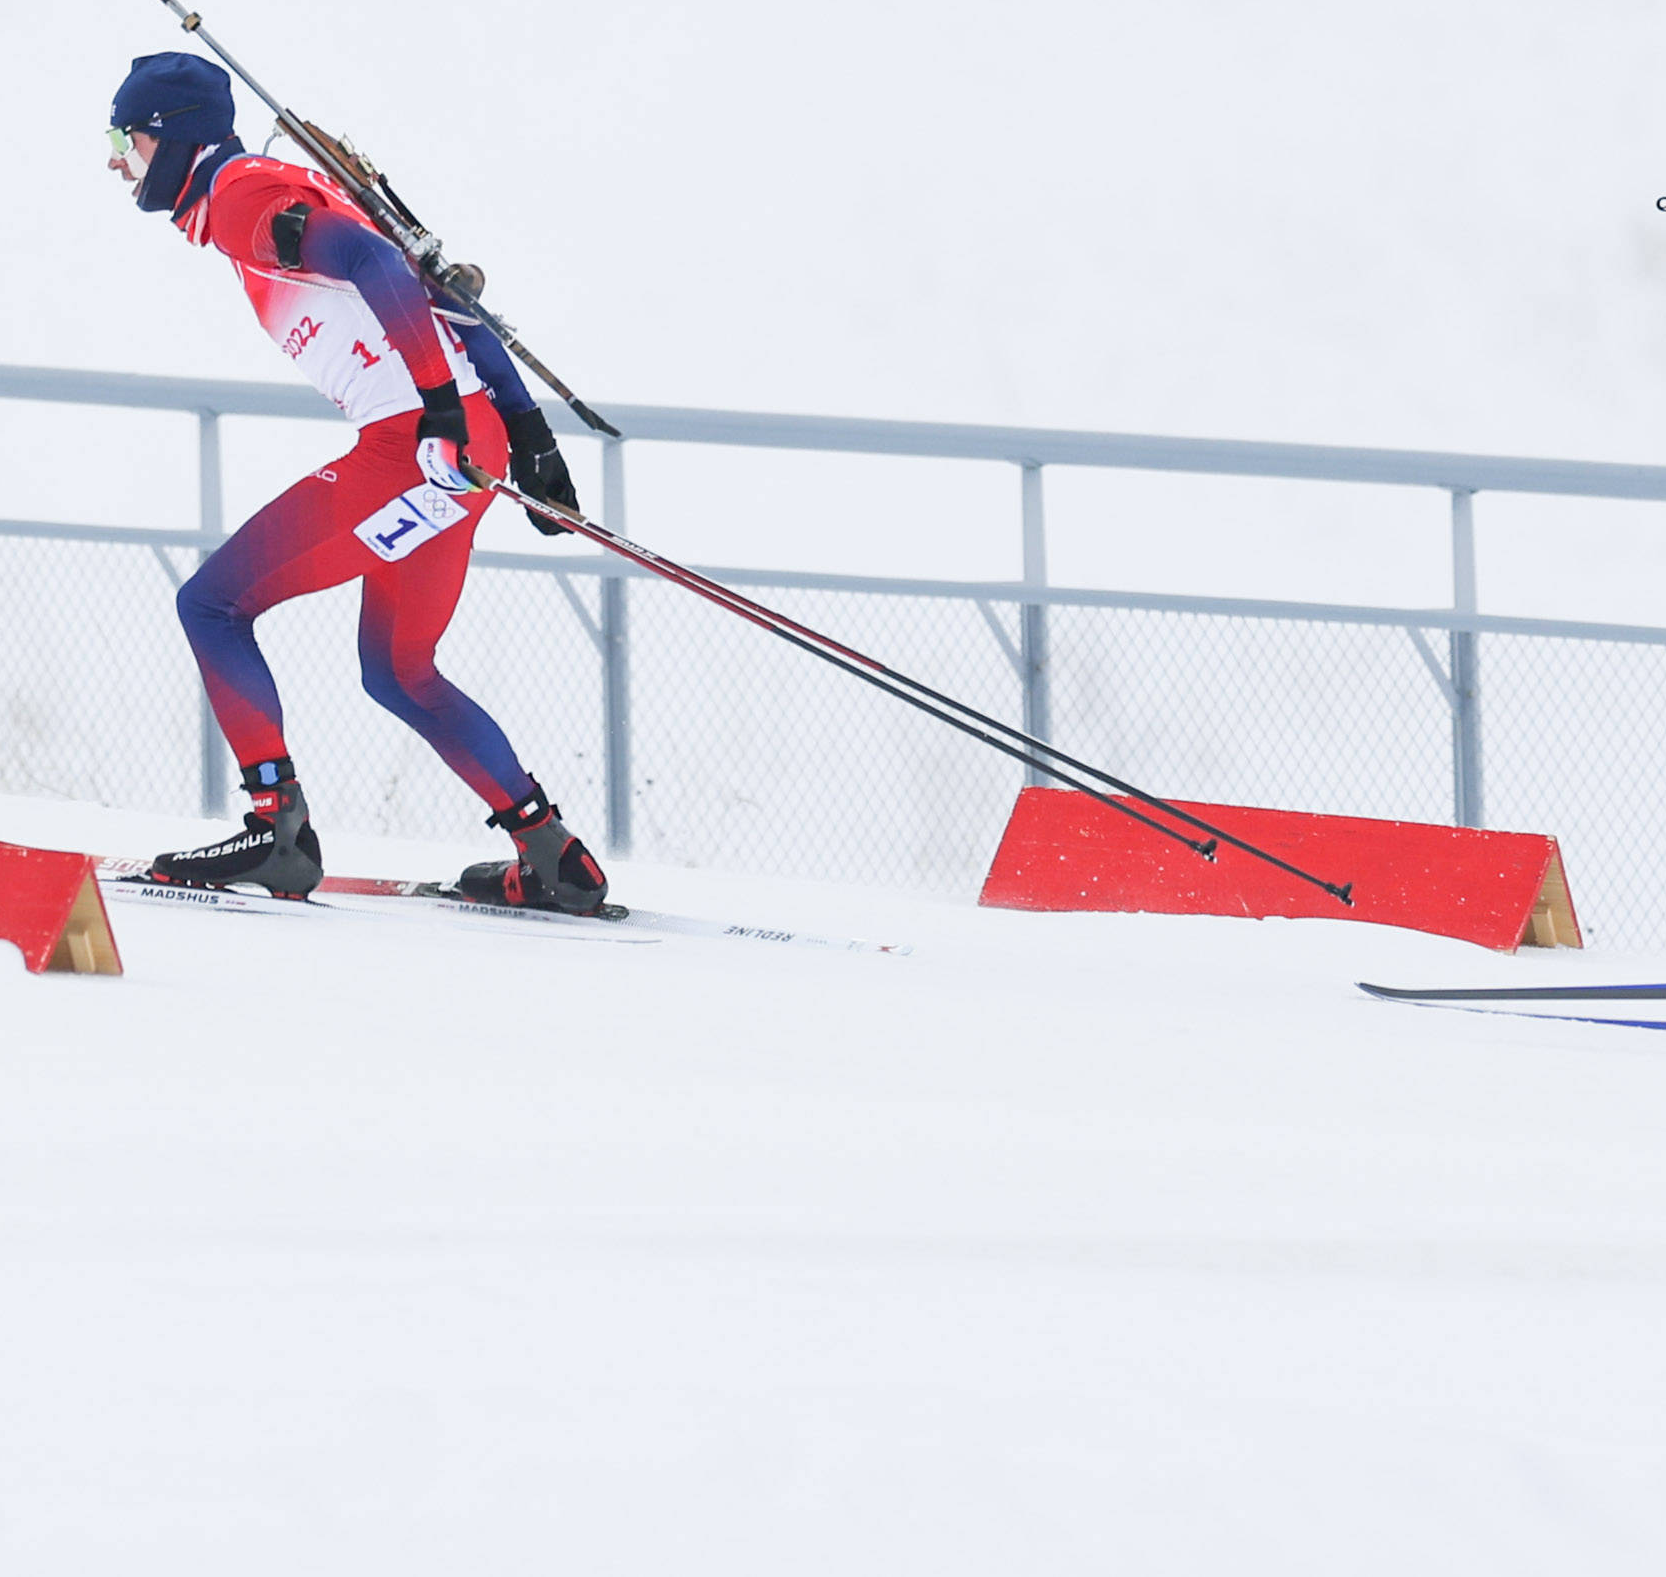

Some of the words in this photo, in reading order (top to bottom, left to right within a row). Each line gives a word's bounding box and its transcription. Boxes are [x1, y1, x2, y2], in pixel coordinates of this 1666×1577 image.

[375, 518, 419, 551] 1
[172, 830, 275, 862] MADSHUS
[140, 887, 220, 905] MADSHUS
[723, 925, 796, 943] REDLINE
